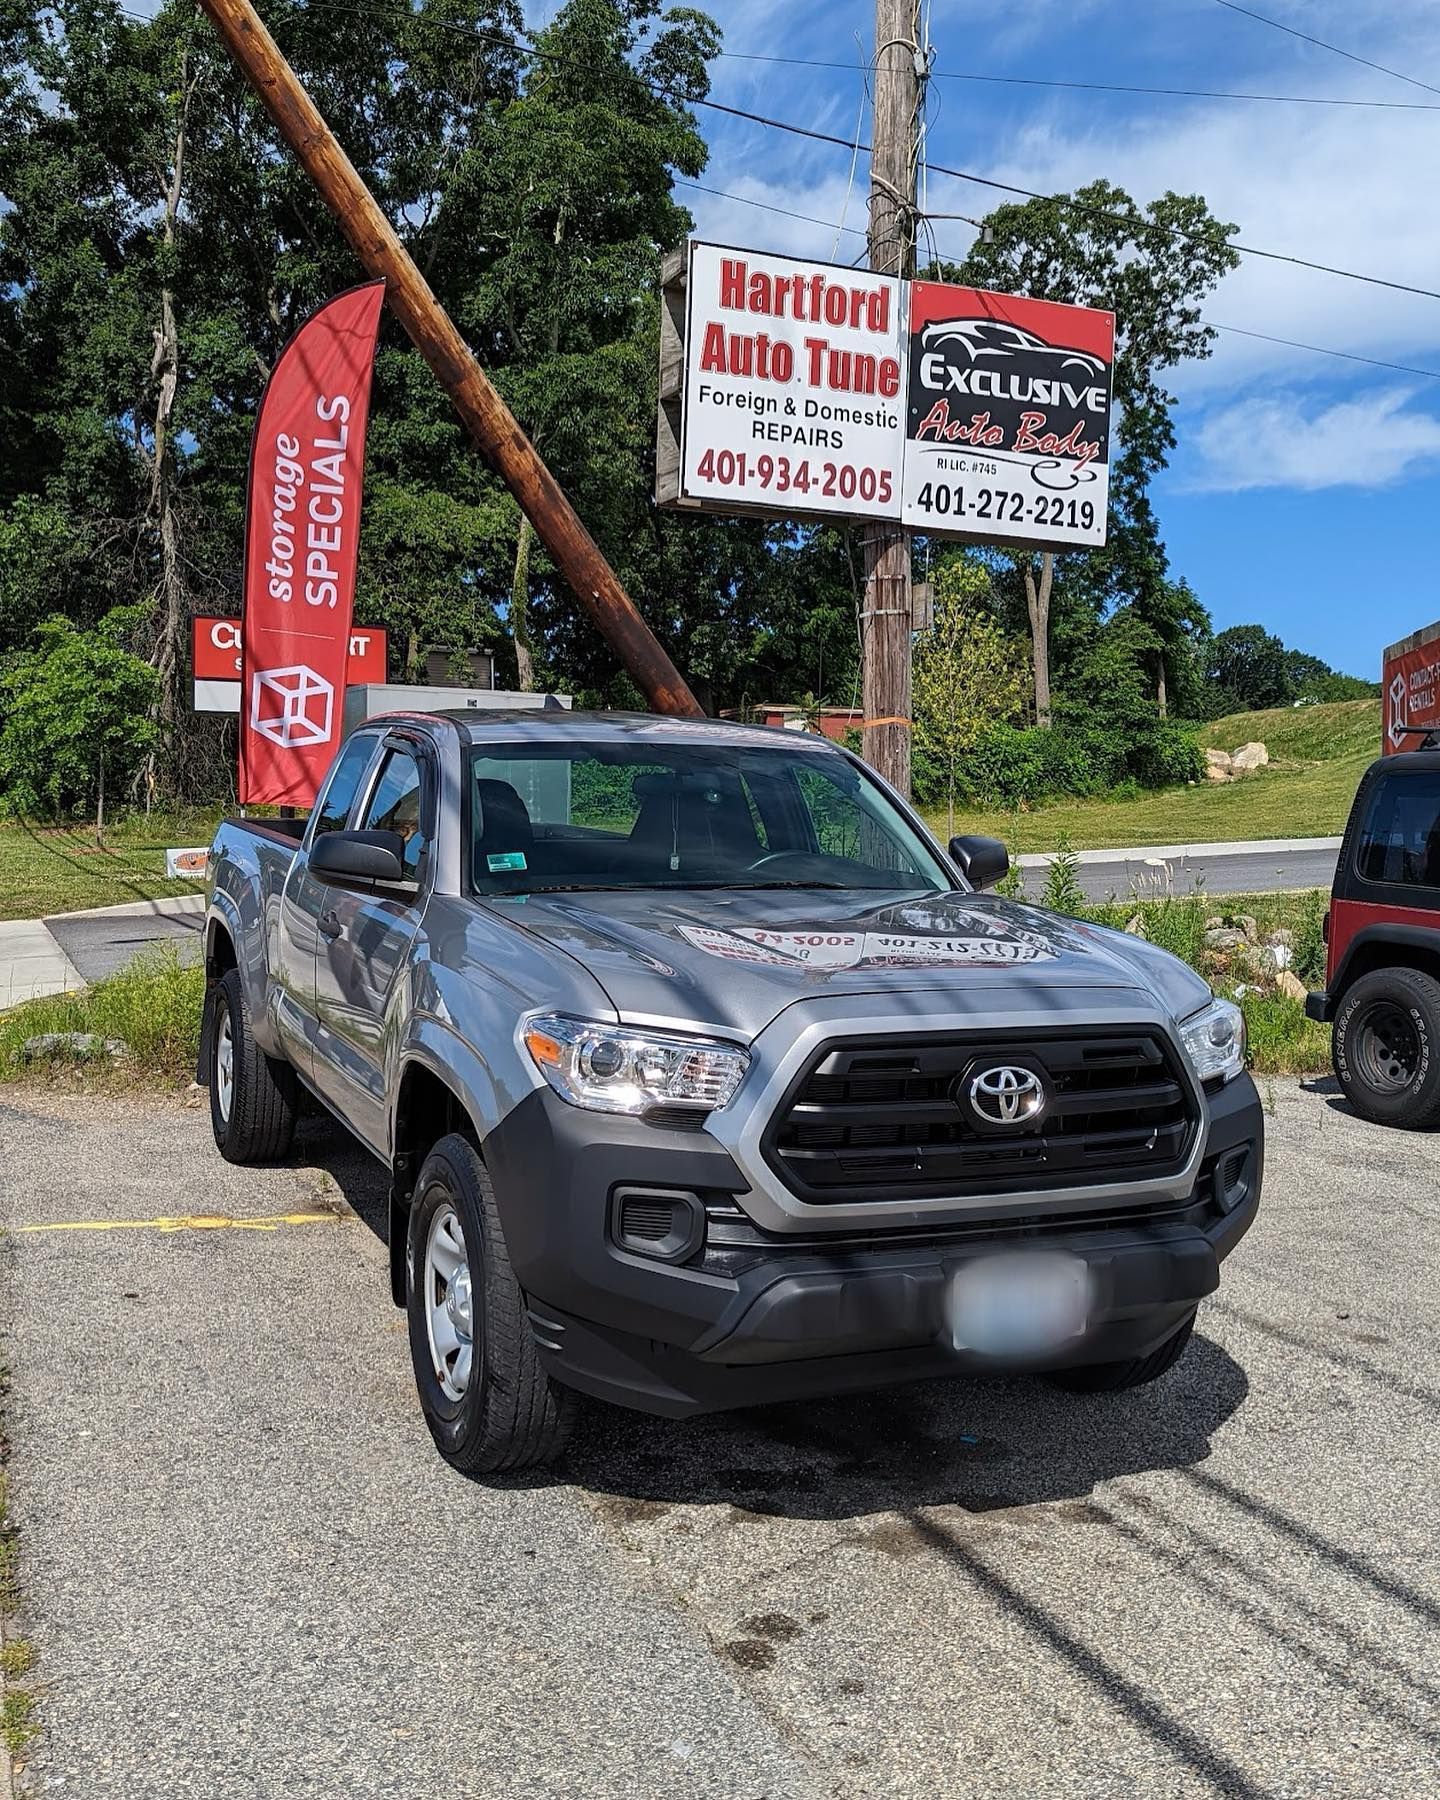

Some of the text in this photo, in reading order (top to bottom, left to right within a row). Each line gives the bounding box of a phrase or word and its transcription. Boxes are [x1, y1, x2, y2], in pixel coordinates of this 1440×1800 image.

[719, 257, 890, 334] Hartford
[699, 321, 900, 398] Auto Tune
[919, 352, 1107, 413] EXCLUSIVE
[699, 385, 898, 429] Foreign & Domestic
[752, 421, 843, 449] REPAIRS
[915, 398, 1100, 472] Auto Body
[305, 394, 351, 609] SPECIALS
[697, 448, 893, 503] 401-934-2005
[917, 482, 1094, 530] 401-272-2219
[972, 463, 997, 475] #745
[266, 432, 306, 603] storage
[1337, 999, 1361, 1083] GENERAL
[1410, 1008, 1430, 1095] GRABBER
